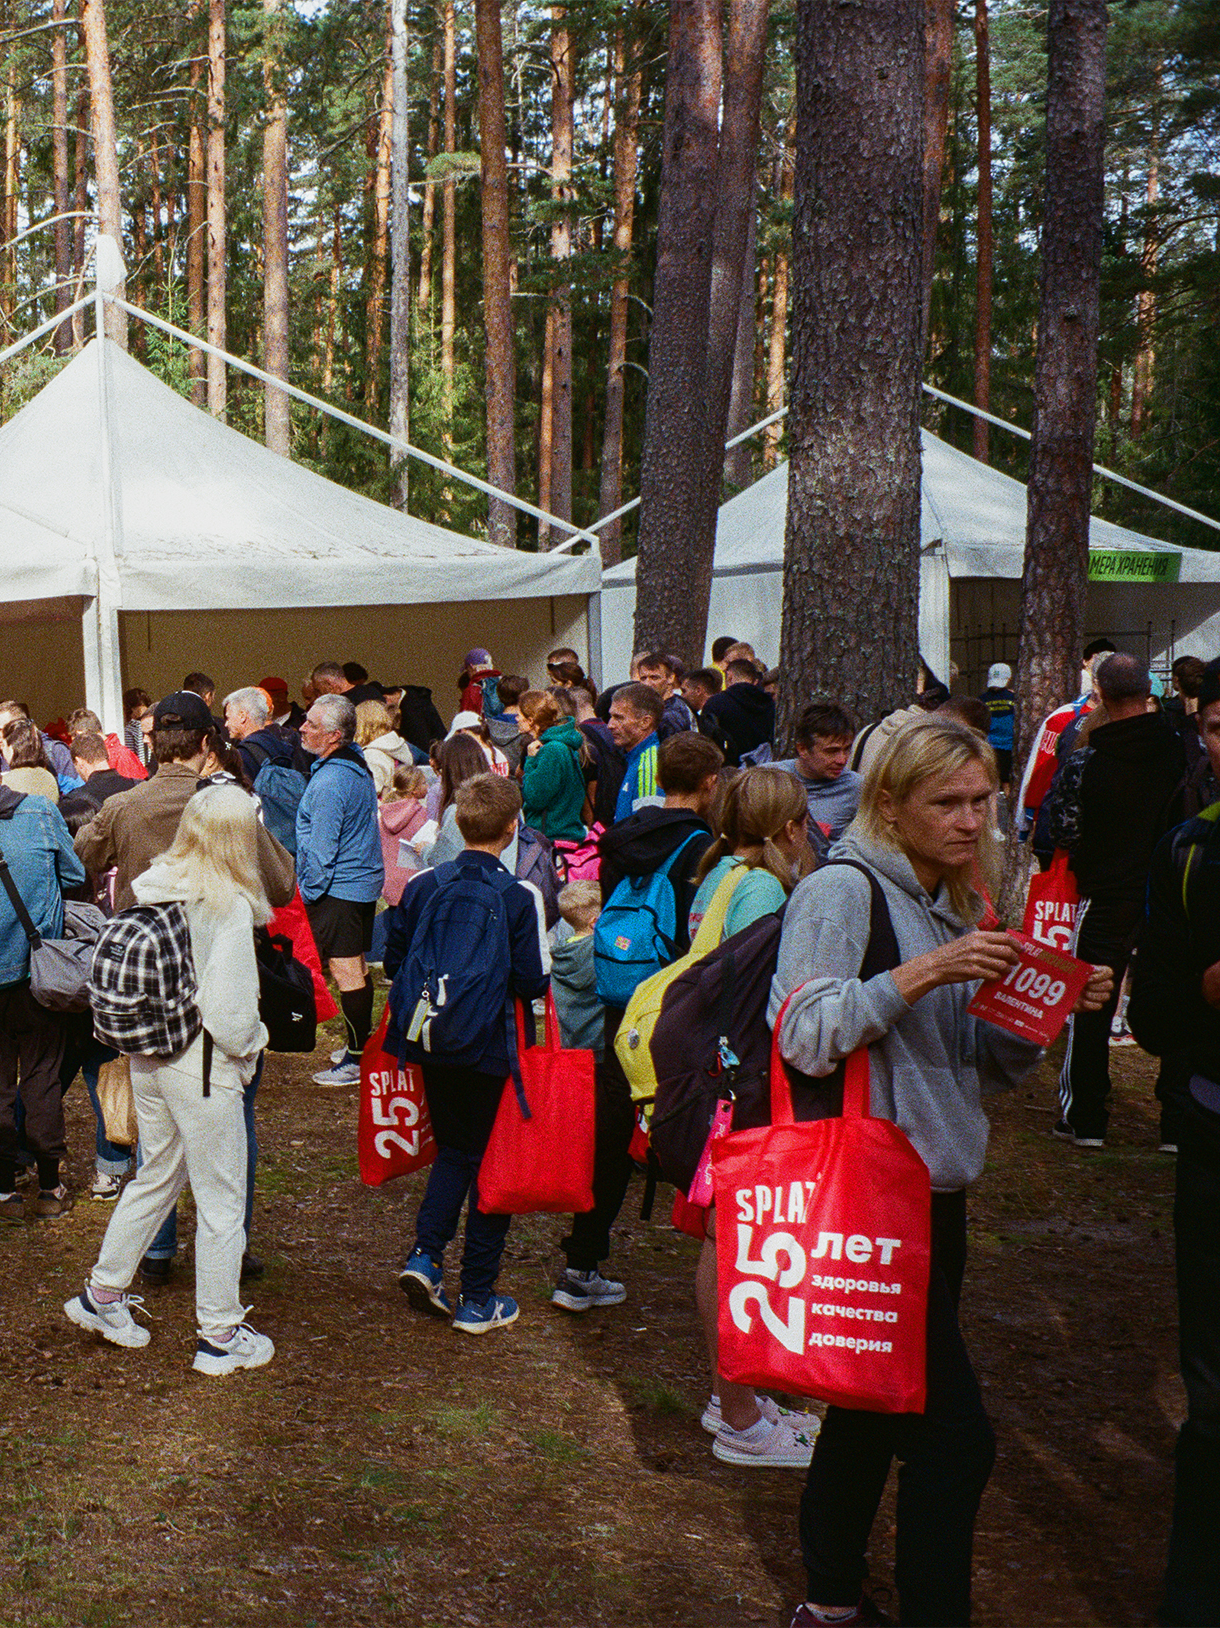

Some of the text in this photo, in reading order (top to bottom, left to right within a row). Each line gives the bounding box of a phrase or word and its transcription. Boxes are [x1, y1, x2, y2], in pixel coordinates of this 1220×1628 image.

[1088, 556, 1169, 576] МЕРА ХРАНЕНИЯ
[1034, 900, 1078, 923] SPLAT
[1003, 962, 1066, 1006] 1099
[993, 991, 1044, 1019] ВАЛЕНТИНА
[369, 1068, 414, 1096] SPLAT
[371, 1096, 419, 1159] 25
[735, 1181, 816, 1225] SPLAT
[810, 1231, 902, 1265] лет
[729, 1223, 807, 1355] 25
[811, 1274, 902, 1294] здоровья
[811, 1303, 899, 1323] качества
[808, 1332, 893, 1354] доверия
